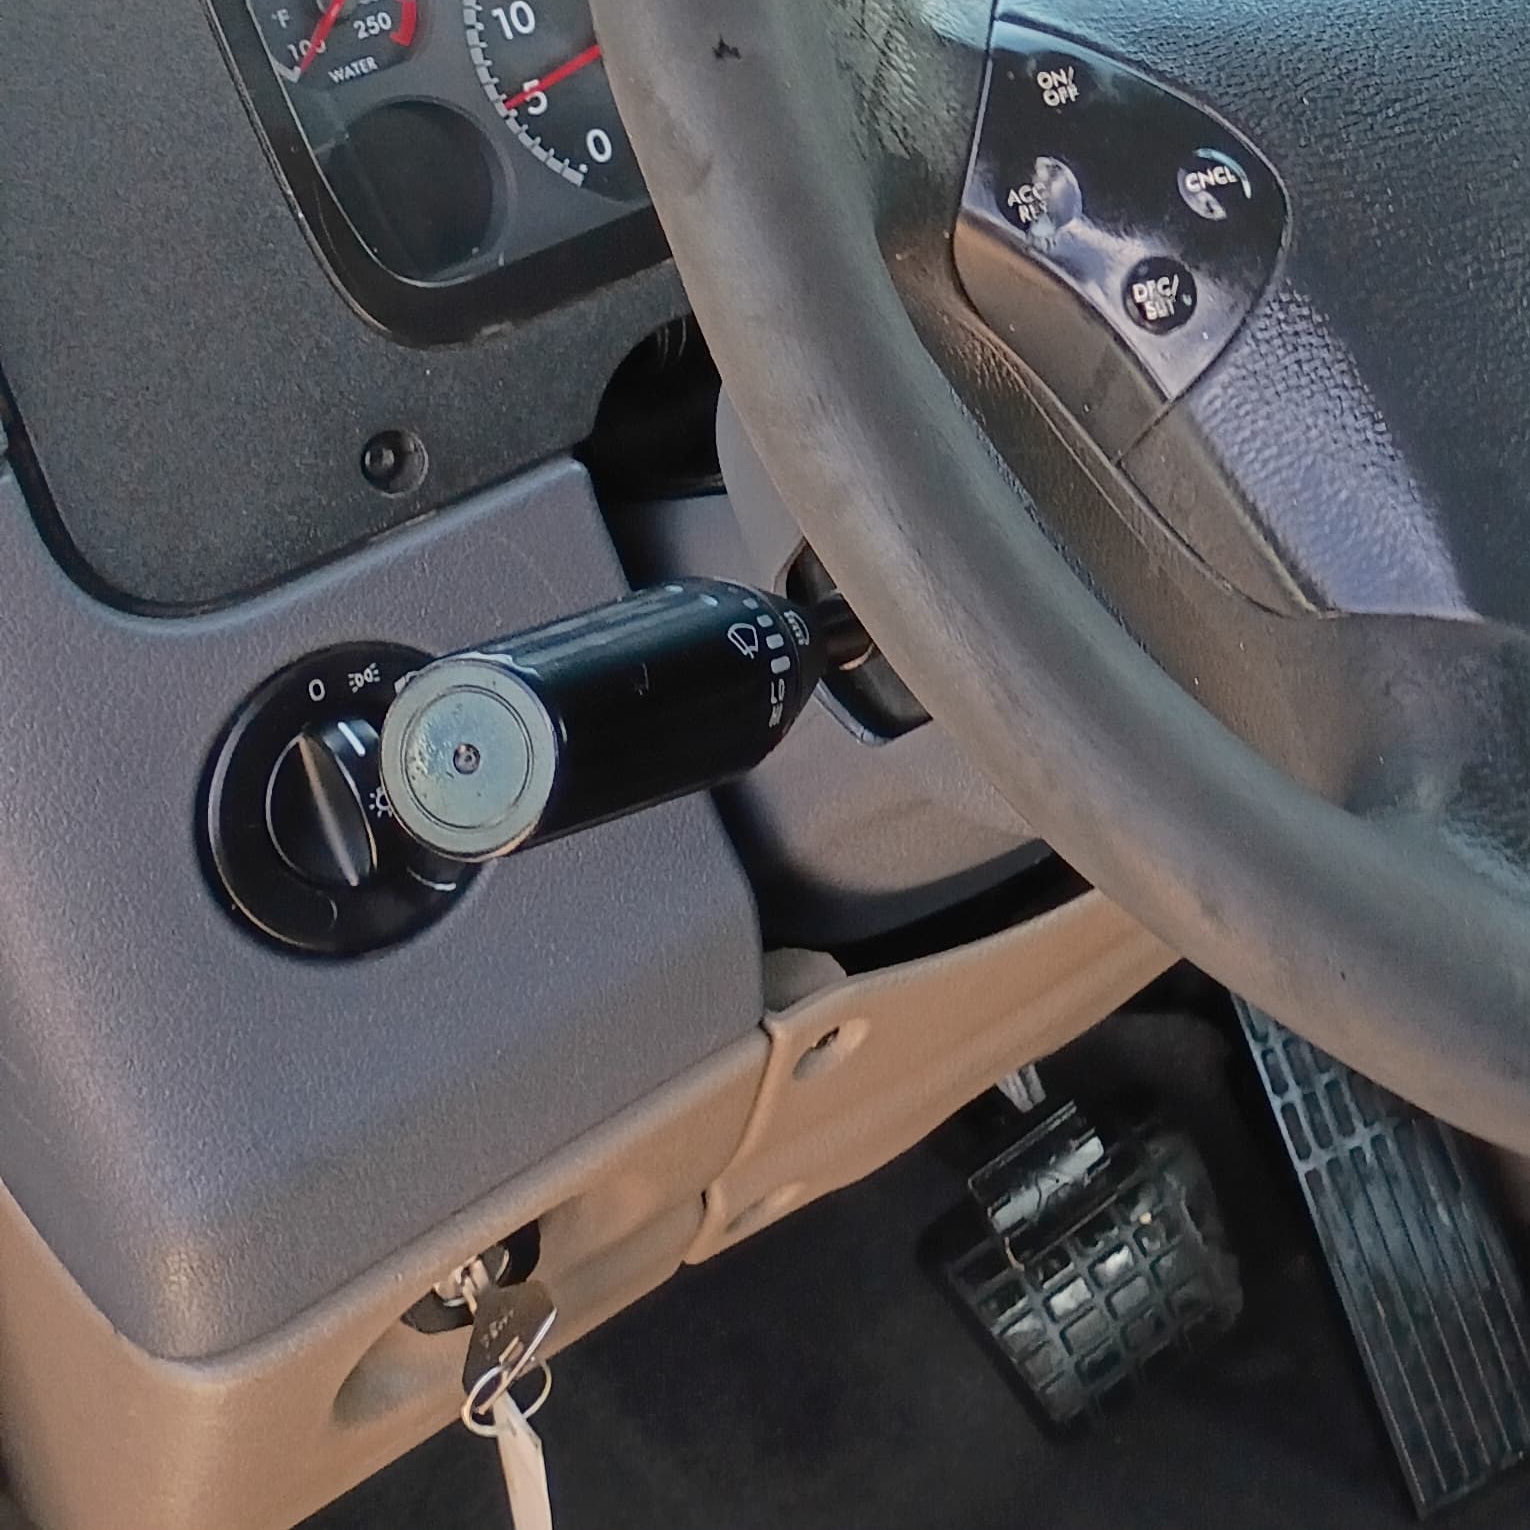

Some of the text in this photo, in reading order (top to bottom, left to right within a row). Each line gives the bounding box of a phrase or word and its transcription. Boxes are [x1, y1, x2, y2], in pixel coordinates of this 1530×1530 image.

[353, 12, 392, 39] 250
[491, 0, 536, 40] 10
[328, 56, 378, 84] WATER
[1037, 66, 1075, 90] ON/
[522, 79, 549, 116] 5
[1042, 85, 1080, 107] OFF
[586, 127, 613, 164] 0
[1185, 166, 1238, 193] CNCL
[308, 678, 326, 702] 0
